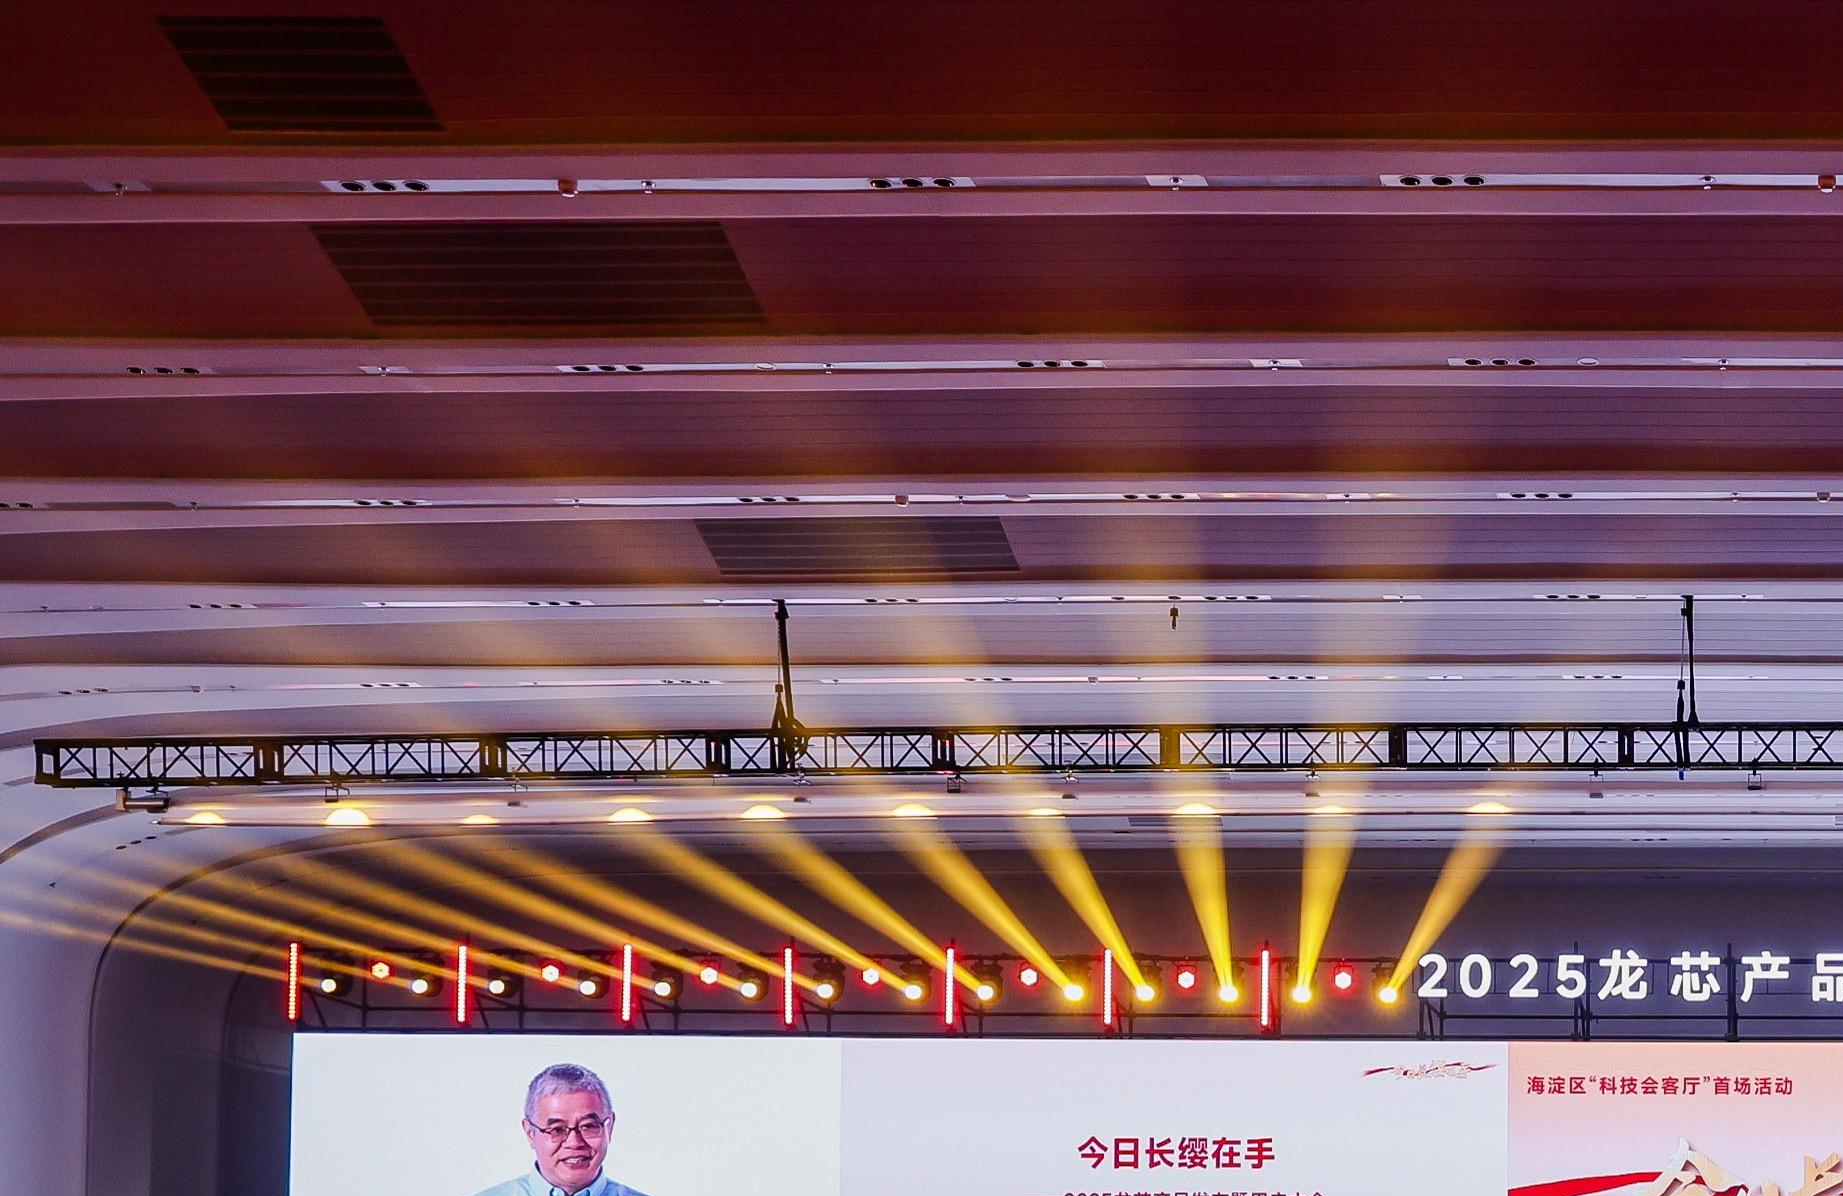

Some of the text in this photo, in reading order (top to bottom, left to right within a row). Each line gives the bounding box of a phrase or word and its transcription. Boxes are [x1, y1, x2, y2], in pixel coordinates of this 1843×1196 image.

[1077, 1136, 1276, 1170] 今日长缨在手
